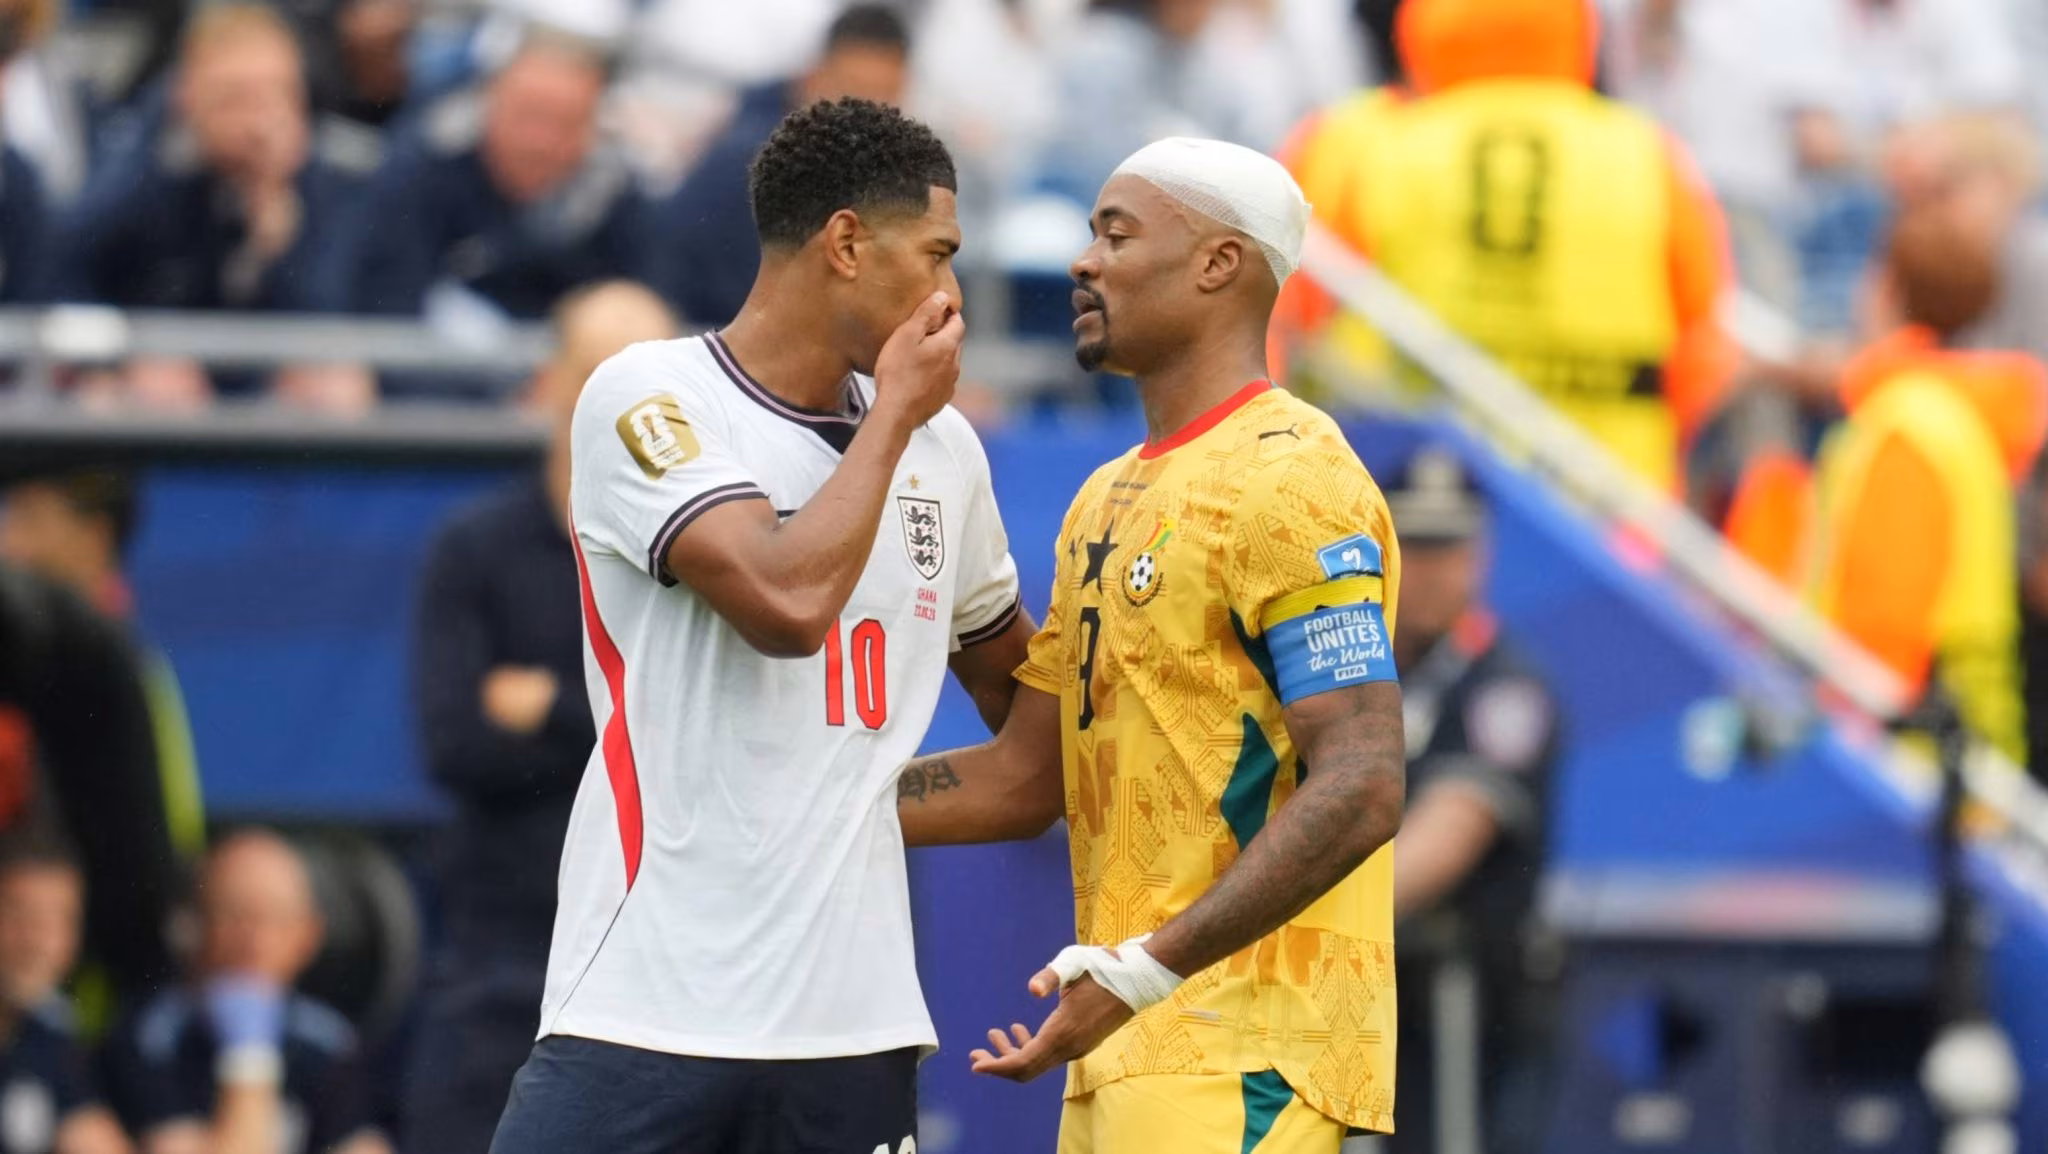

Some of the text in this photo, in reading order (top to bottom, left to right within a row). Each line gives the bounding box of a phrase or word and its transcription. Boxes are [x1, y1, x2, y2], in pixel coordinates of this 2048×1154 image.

[1304, 610, 1376, 635] FOOTBALL
[1307, 624, 1381, 653] UNITES
[1307, 642, 1385, 672] the World
[825, 615, 887, 730] 10
[1337, 666, 1365, 679] FIFA
